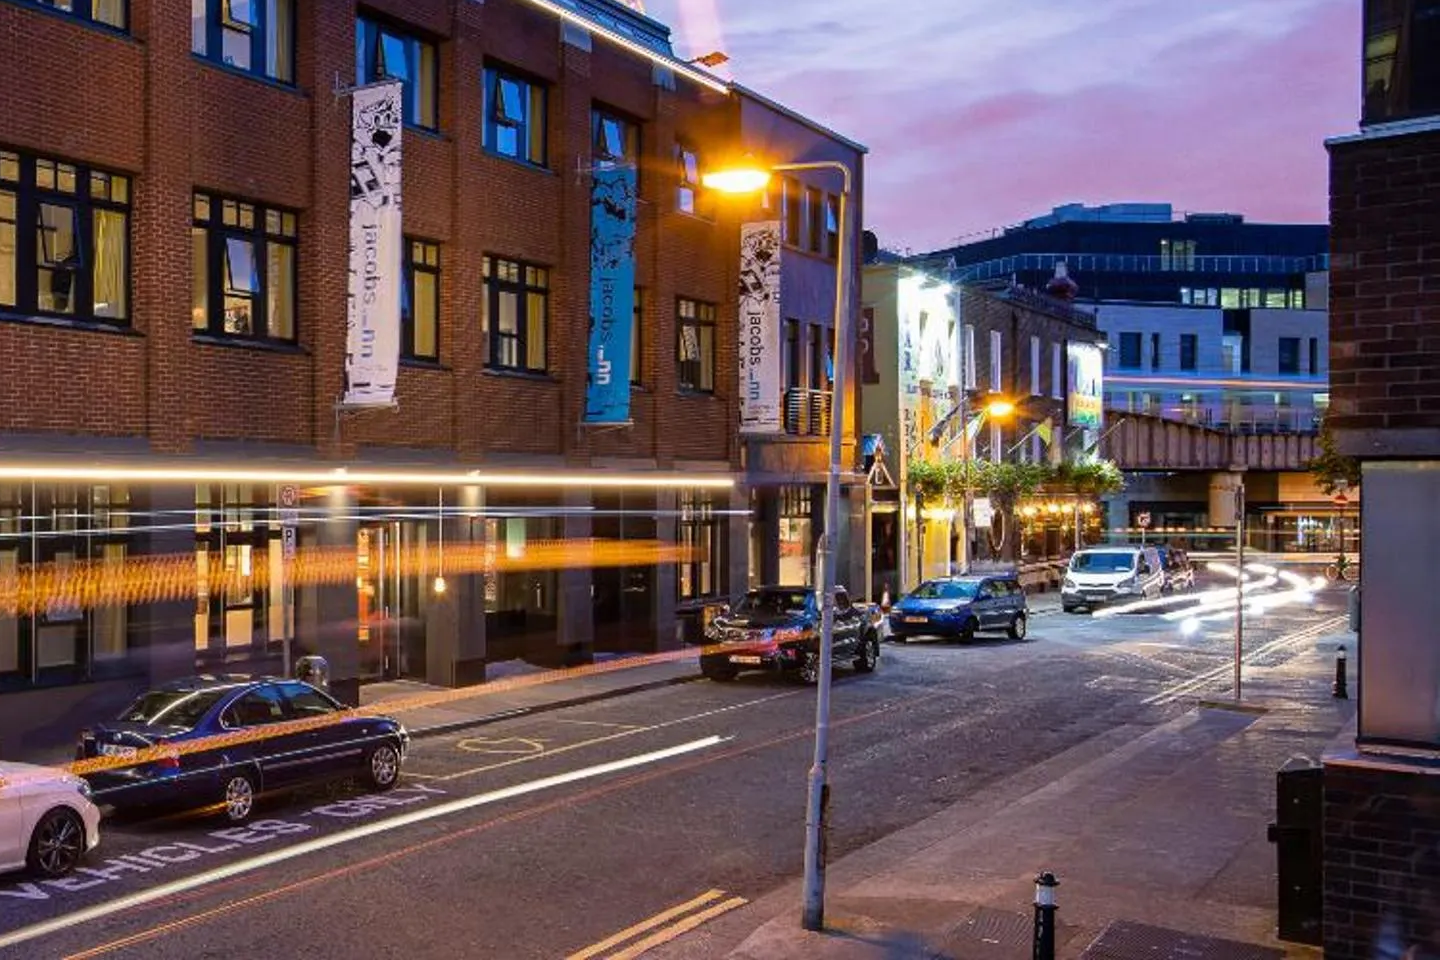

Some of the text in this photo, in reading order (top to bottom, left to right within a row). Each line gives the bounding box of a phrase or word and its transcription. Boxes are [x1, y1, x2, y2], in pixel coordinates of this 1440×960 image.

[361, 223, 382, 307] jacobs
[599, 276, 617, 344] jacobs
[747, 311, 764, 366] jacobs
